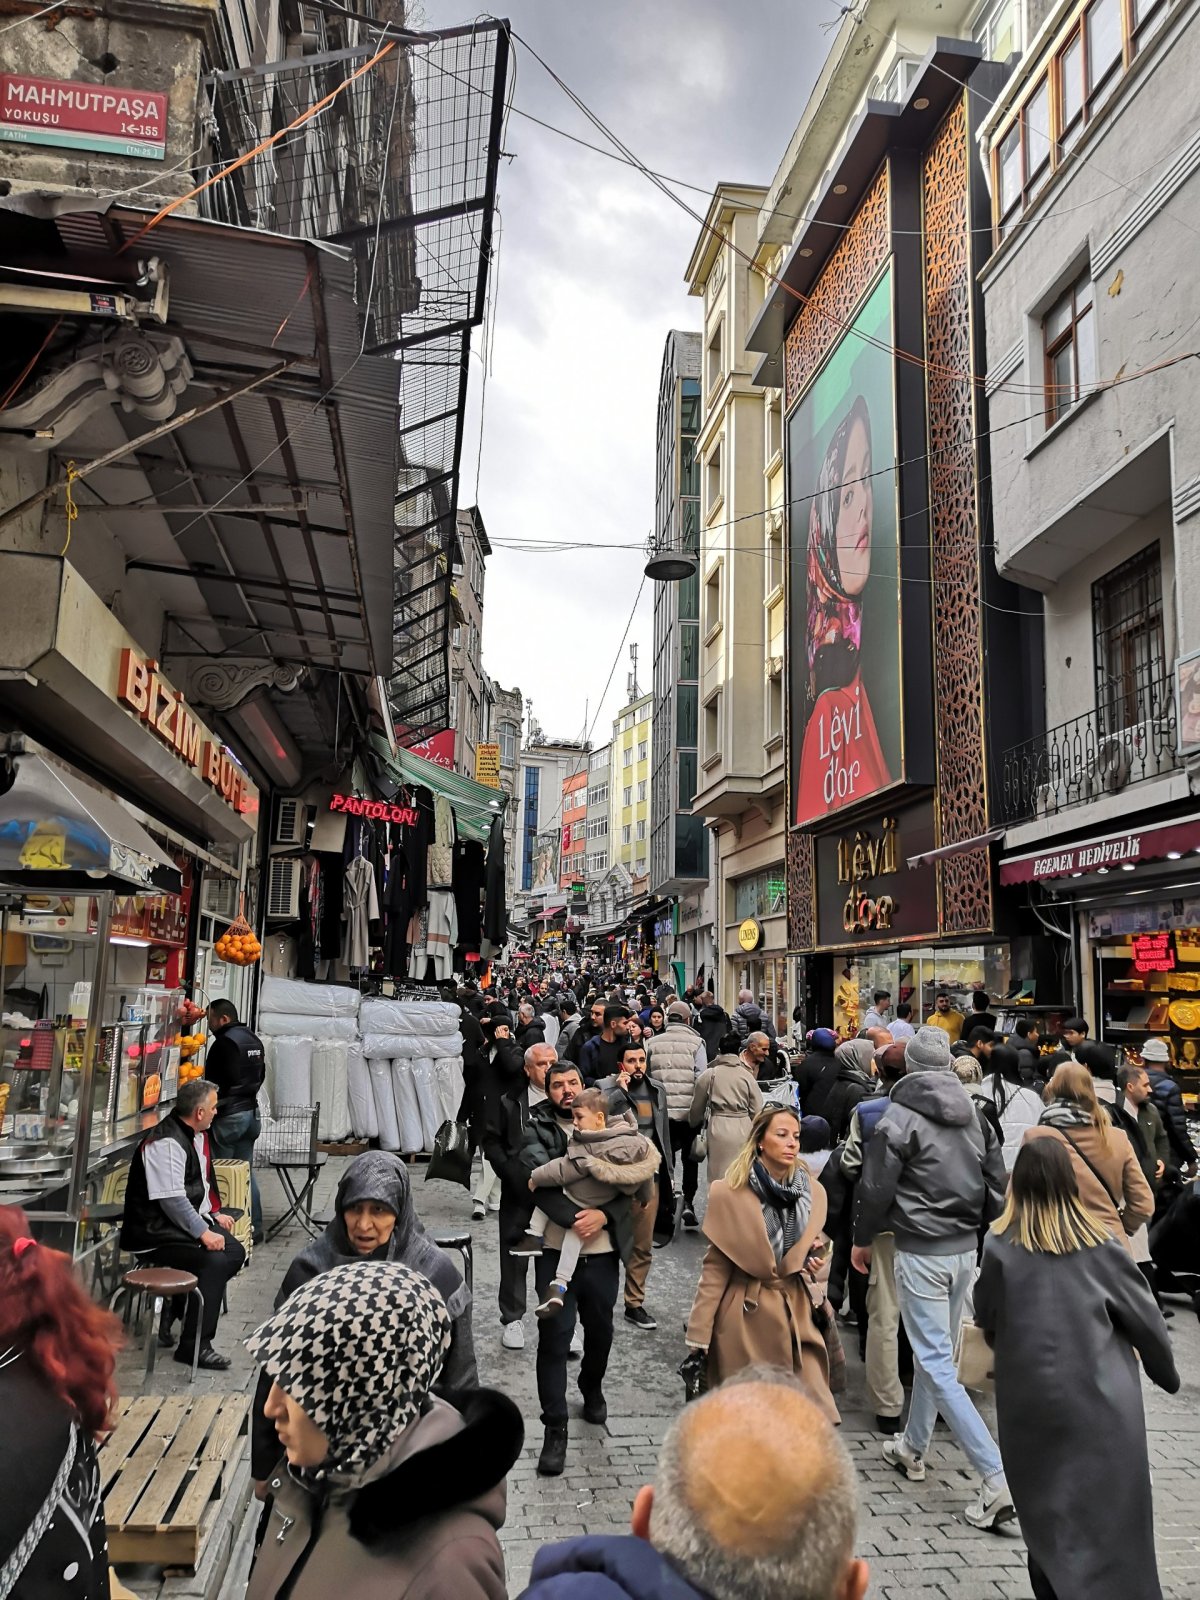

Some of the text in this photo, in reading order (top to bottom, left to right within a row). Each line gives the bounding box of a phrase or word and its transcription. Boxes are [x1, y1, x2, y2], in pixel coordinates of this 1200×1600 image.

[4, 108, 59, 124] YOKUŞU
[8, 82, 159, 120] MAHMUTPAŞA
[118, 648, 200, 767] BİZİM
[819, 686, 863, 760] Lêvi
[824, 754, 860, 804] d'or
[332, 794, 415, 825] PANTOLON
[838, 817, 897, 885] Lêvi
[1033, 836, 1141, 876] EGEMEN HEDİYELİK
[740, 928, 756, 942] LINENS
